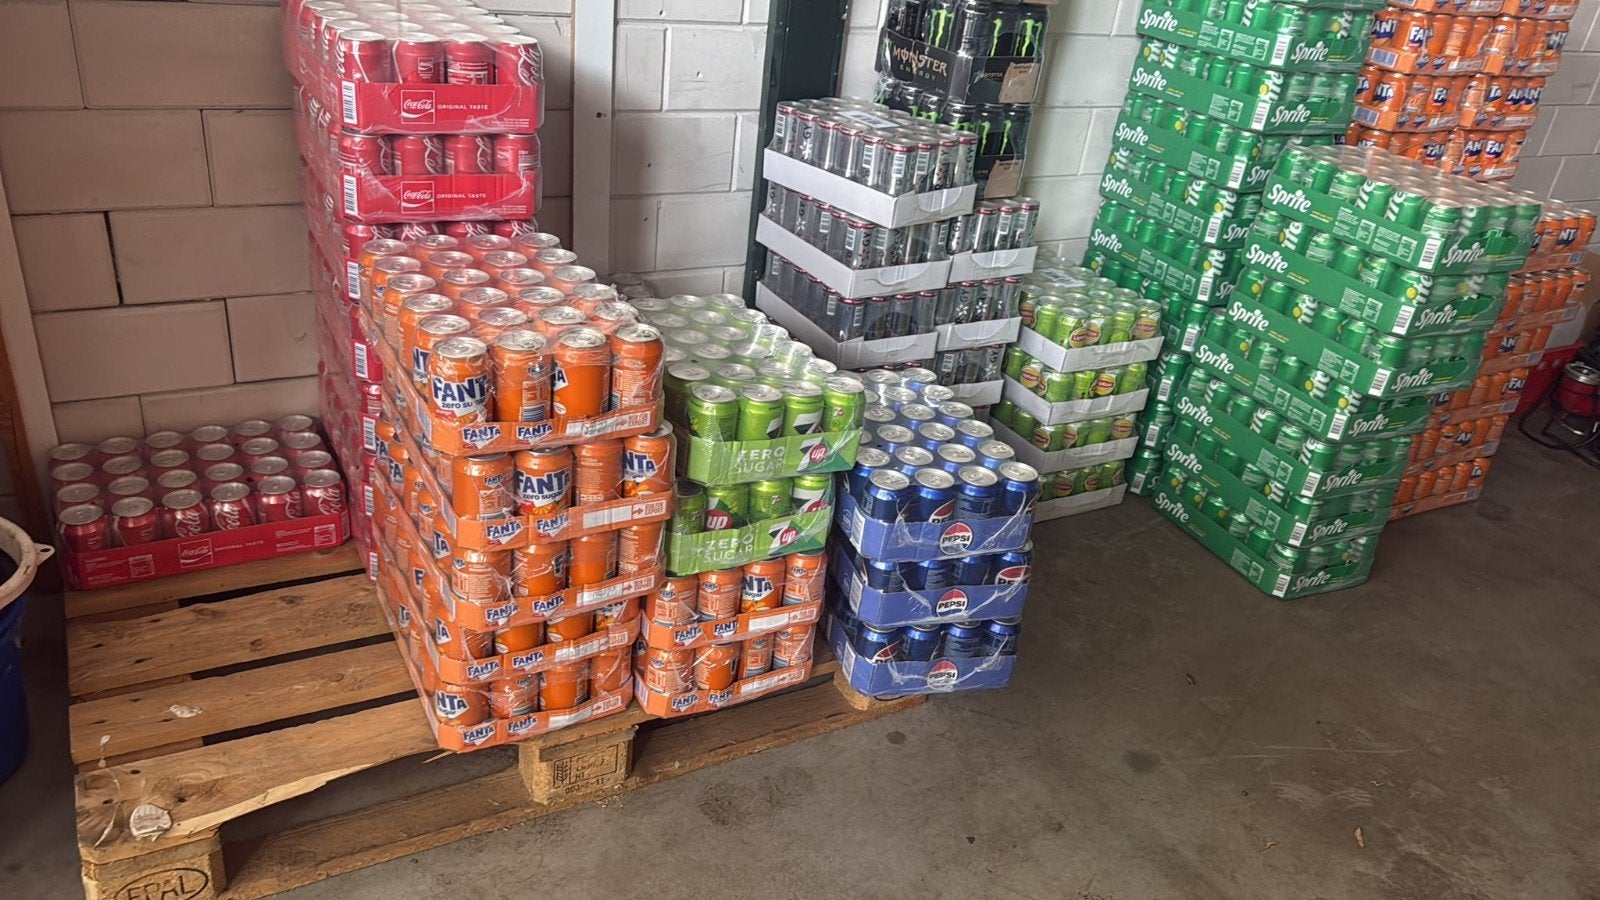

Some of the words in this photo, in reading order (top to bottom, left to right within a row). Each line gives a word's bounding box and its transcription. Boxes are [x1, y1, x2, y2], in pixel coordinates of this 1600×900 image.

[1140, 9, 1178, 32] Sprite
[892, 45, 948, 77] MONSTER
[1290, 40, 1329, 64] Sprite
[1132, 67, 1167, 90] Sprite
[403, 99, 433, 110] Coca-Cola
[1271, 104, 1311, 126] Sprite
[1115, 122, 1148, 146] Sprite
[403, 189, 432, 200] Coca-Cola
[1102, 173, 1133, 198] Sprite
[1268, 183, 1312, 213] Sprite
[1091, 228, 1122, 253] Sprite
[1245, 243, 1289, 274] Sprite
[1442, 242, 1485, 265] Sprite
[1228, 301, 1270, 332] Sprite
[1416, 304, 1458, 327] Sprite
[1195, 344, 1235, 375] Sprite
[432, 374, 488, 402] FANT
[1391, 367, 1434, 391] Sprite
[1177, 395, 1214, 427] Sprite
[463, 426, 501, 441] FANTA
[517, 423, 553, 437] FANTA
[1350, 413, 1389, 437] Sprite
[1167, 443, 1203, 474] Sprite
[1321, 468, 1363, 492] Sprite
[1154, 492, 1190, 523] Sprite
[487, 521, 522, 537] FANTA
[537, 514, 569, 530] FANTA
[1309, 519, 1348, 542] Sprite
[942, 534, 971, 544] PEPSI
[1293, 570, 1331, 592] Sprite
[486, 604, 519, 620] FANTA
[534, 595, 564, 611] FANTA
[675, 626, 703, 642] FANTA
[467, 660, 500, 676] FANTA
[513, 651, 544, 666] FANTA
[672, 694, 698, 708] FANTA
[463, 725, 495, 741] FANTA
[508, 715, 537, 731] FANTA
